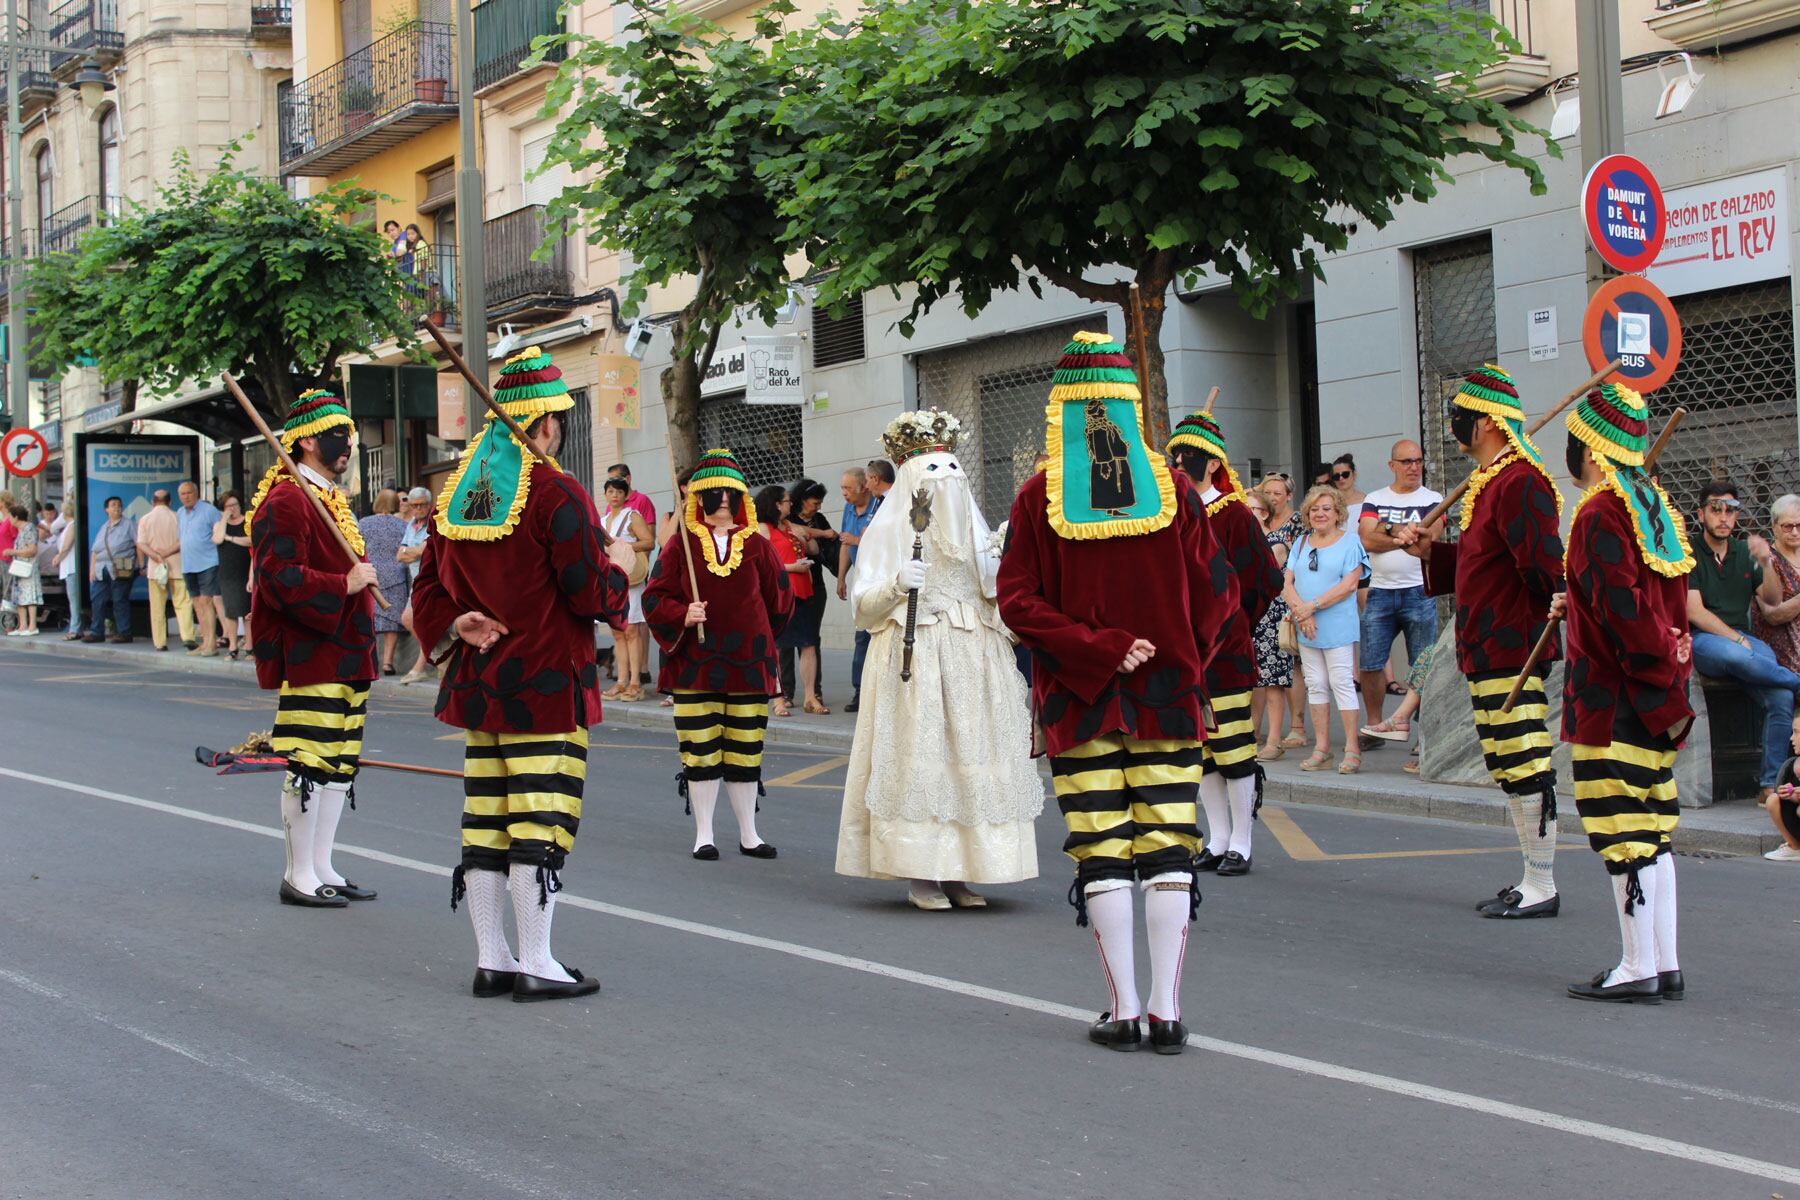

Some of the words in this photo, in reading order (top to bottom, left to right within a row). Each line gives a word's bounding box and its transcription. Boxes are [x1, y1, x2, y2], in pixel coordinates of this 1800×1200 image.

[1607, 187, 1646, 205] DAMUNT
[1607, 205, 1623, 220] DE
[1632, 209, 1646, 223] LA
[1665, 201, 1699, 229] ACIÓN
[1702, 201, 1718, 222] DE
[1720, 189, 1776, 218] CALZADO
[1608, 223, 1647, 242] VORERA
[1711, 224, 1735, 261] EL
[1738, 215, 1776, 259] REY
[728, 353, 745, 373] del
[1621, 354, 1646, 368] BUS
[768, 366, 790, 377] Racó
[768, 376, 783, 387] del
[785, 376, 801, 387] Xef
[99, 453, 180, 469] DECATHLON
